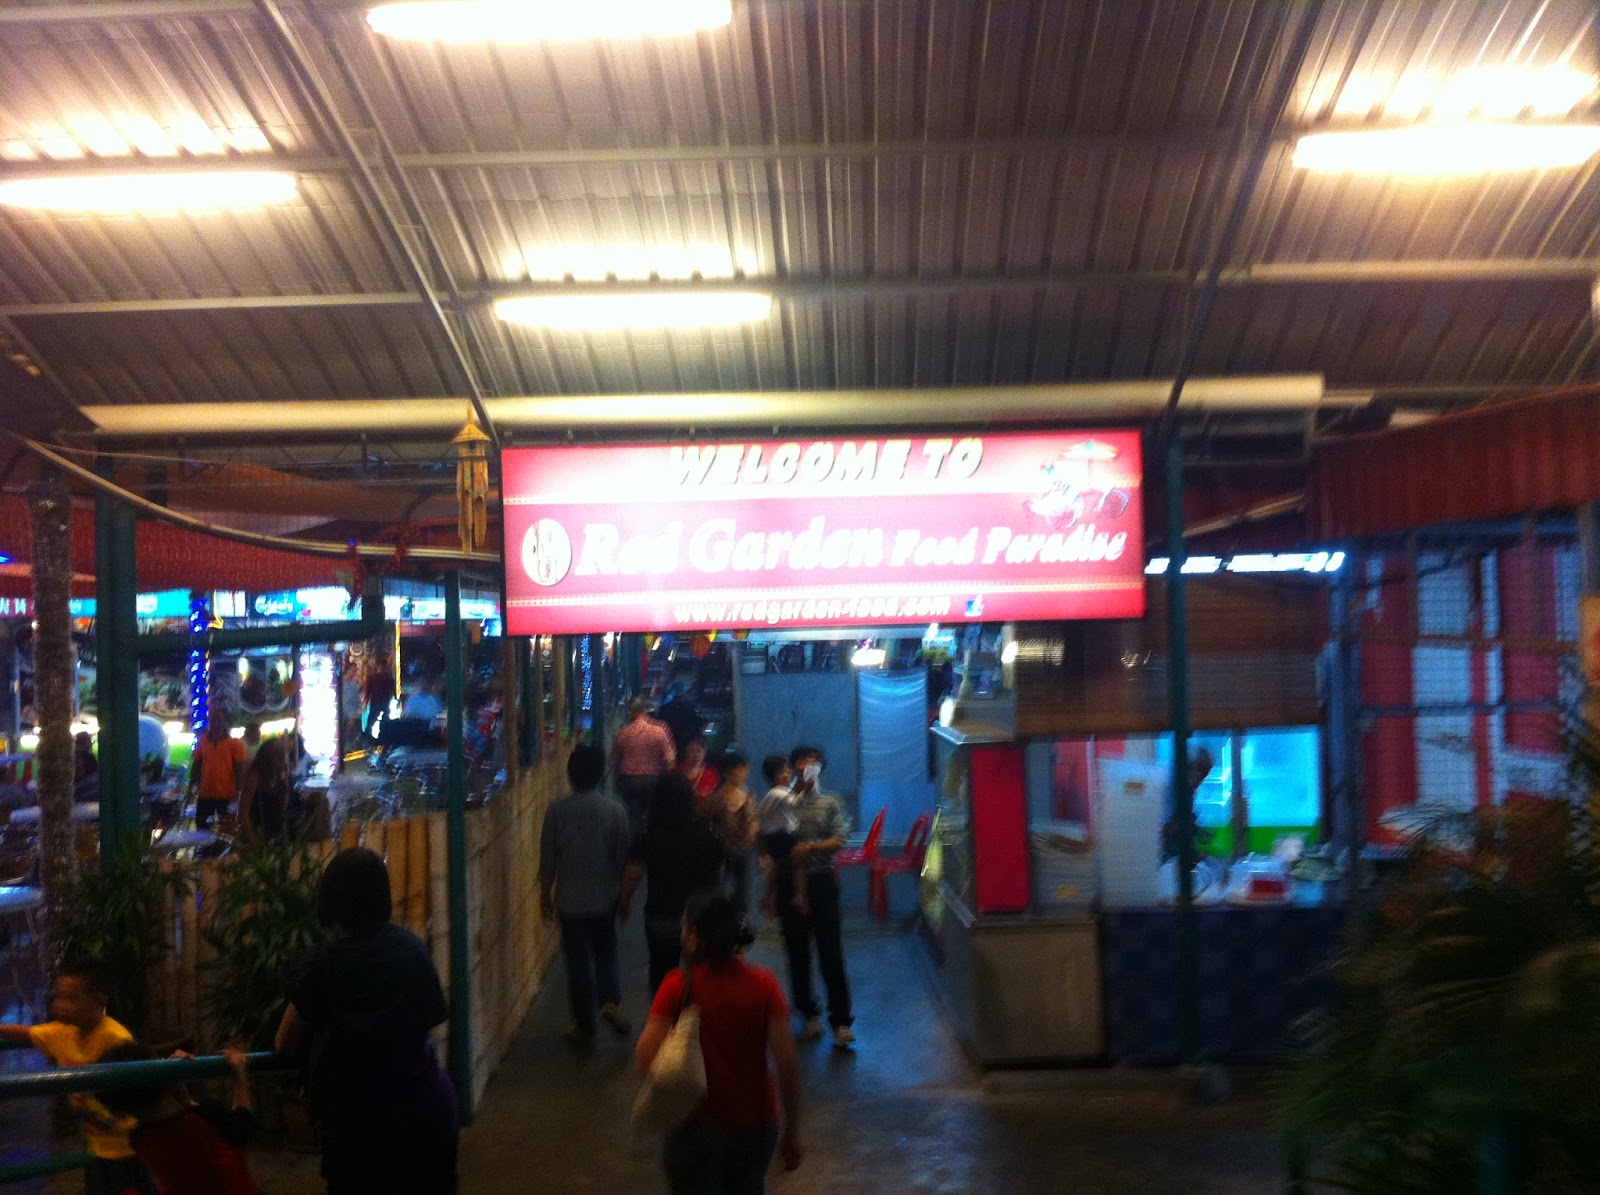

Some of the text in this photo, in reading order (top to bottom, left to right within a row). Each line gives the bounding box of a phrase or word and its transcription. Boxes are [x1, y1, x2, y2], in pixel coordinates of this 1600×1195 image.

[668, 436, 984, 484] WELCOME TO
[574, 519, 683, 576] Red
[688, 514, 884, 573] Garden
[888, 526, 979, 567] Food
[980, 523, 1128, 565] Paradise
[674, 596, 951, 624] www.redgarden-food.com
